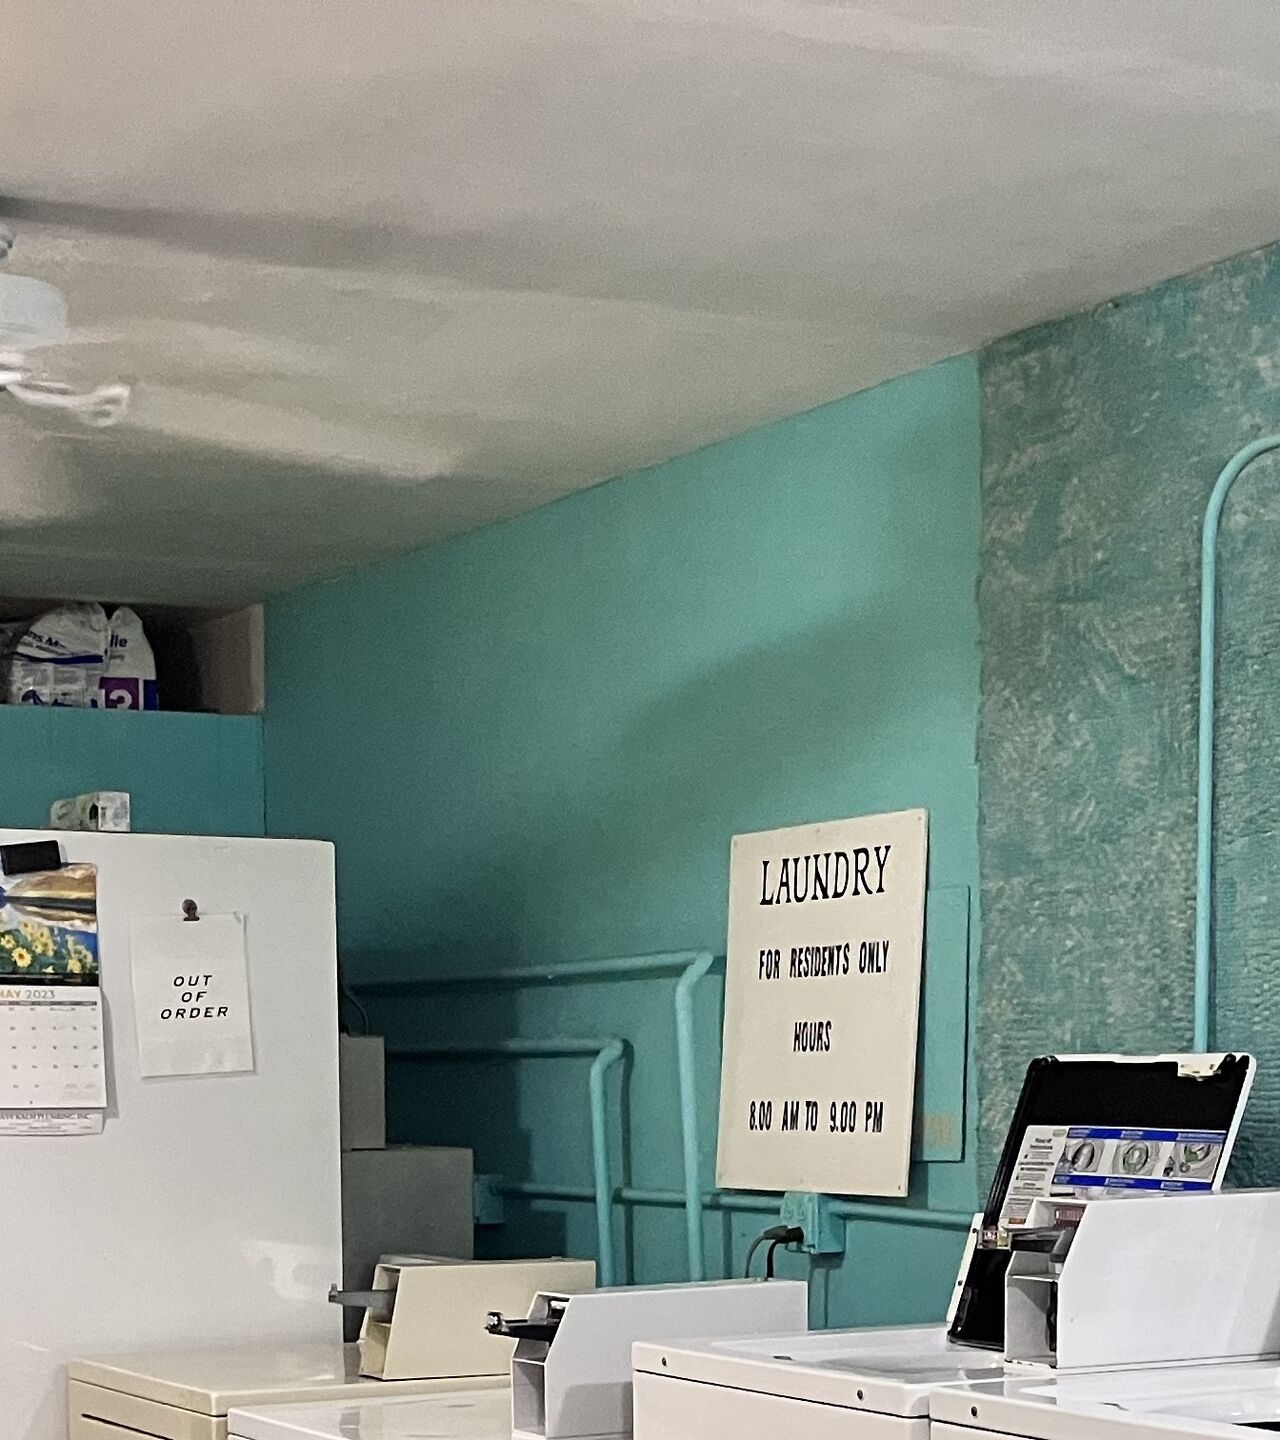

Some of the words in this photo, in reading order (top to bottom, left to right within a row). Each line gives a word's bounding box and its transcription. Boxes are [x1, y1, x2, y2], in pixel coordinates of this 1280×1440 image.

[759, 845, 892, 906] LAUNDRY
[759, 948, 781, 980] FOR
[789, 942, 850, 978] RESIDENTS
[858, 940, 890, 974] ONLY
[173, 975, 214, 987] OUT
[26, 990, 56, 999] 2023
[181, 991, 207, 1003] OF
[160, 1006, 229, 1020] ORDER
[793, 1021, 832, 1052] HOURS
[749, 1100, 772, 1131] 8.00
[781, 1101, 799, 1131] AM
[804, 1101, 819, 1131] TO
[829, 1101, 857, 1133] 9.00
[864, 1101, 885, 1133] PM
